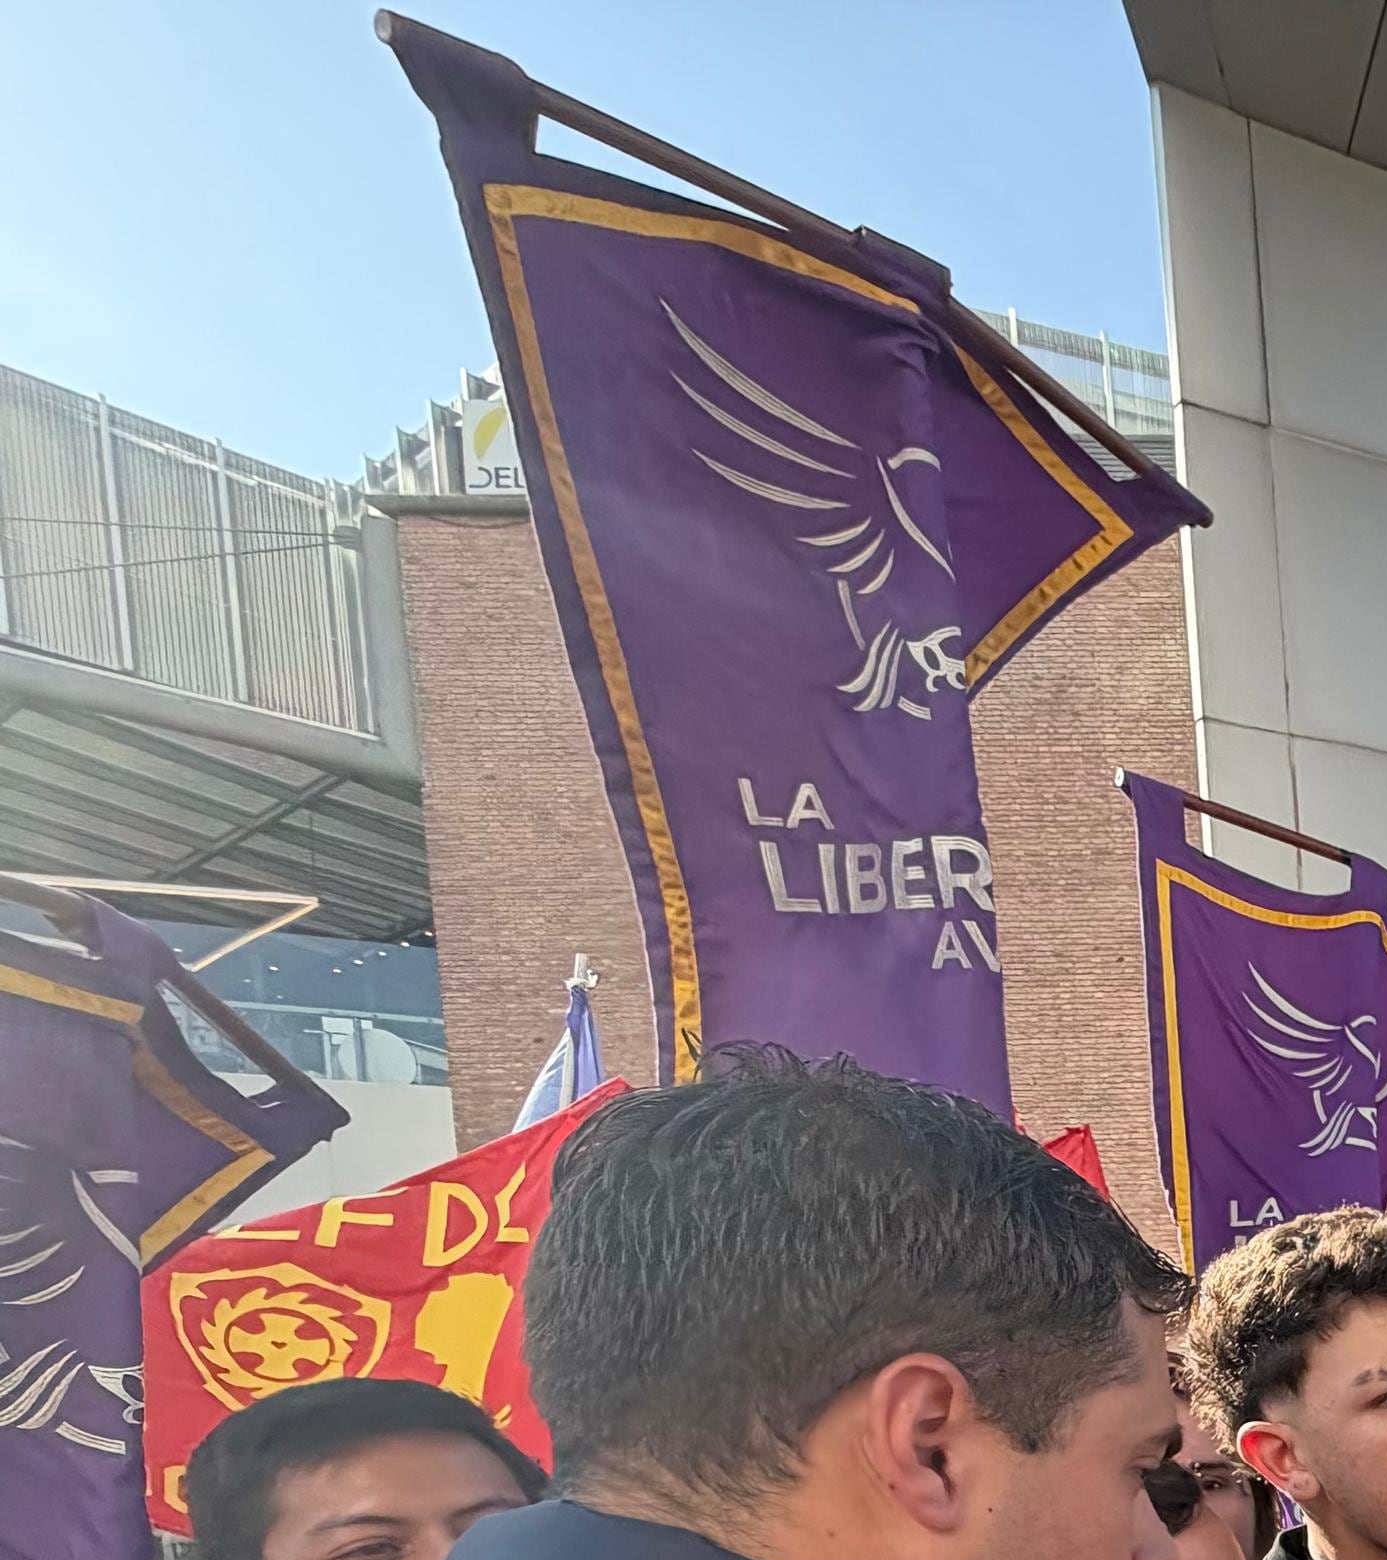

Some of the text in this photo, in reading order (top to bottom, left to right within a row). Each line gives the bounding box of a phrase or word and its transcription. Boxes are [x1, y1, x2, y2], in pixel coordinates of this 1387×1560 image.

[737, 777, 835, 831] LA
[758, 835, 997, 915] LIBER
[1229, 1196, 1284, 1228] LA
